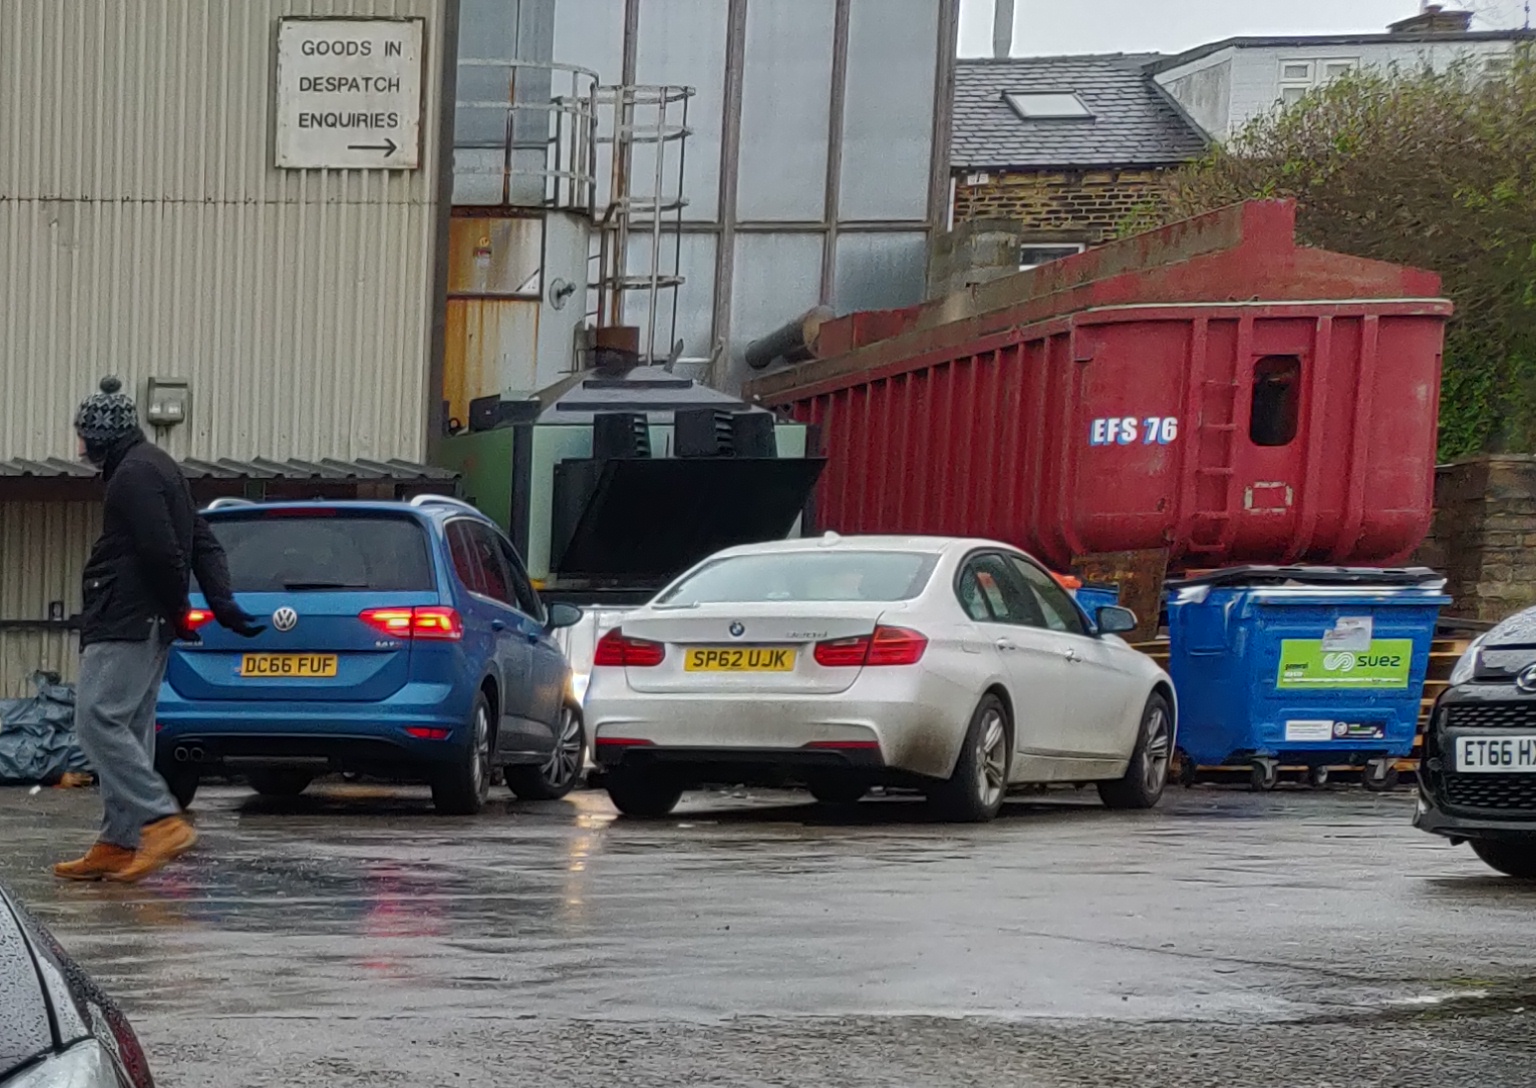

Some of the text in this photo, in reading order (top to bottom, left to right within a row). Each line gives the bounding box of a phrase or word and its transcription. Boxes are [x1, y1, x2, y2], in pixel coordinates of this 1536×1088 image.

[301, 40, 402, 56] GOODS IN
[299, 76, 401, 93] DESPATCH
[298, 112, 399, 129] ENQUIRIES
[1090, 416, 1179, 446] EFS 76
[245, 656, 335, 674] DC66 FUF
[692, 650, 787, 667] SP62 UJK
[1357, 655, 1401, 667] suez
[1464, 740, 1513, 766] ET66
